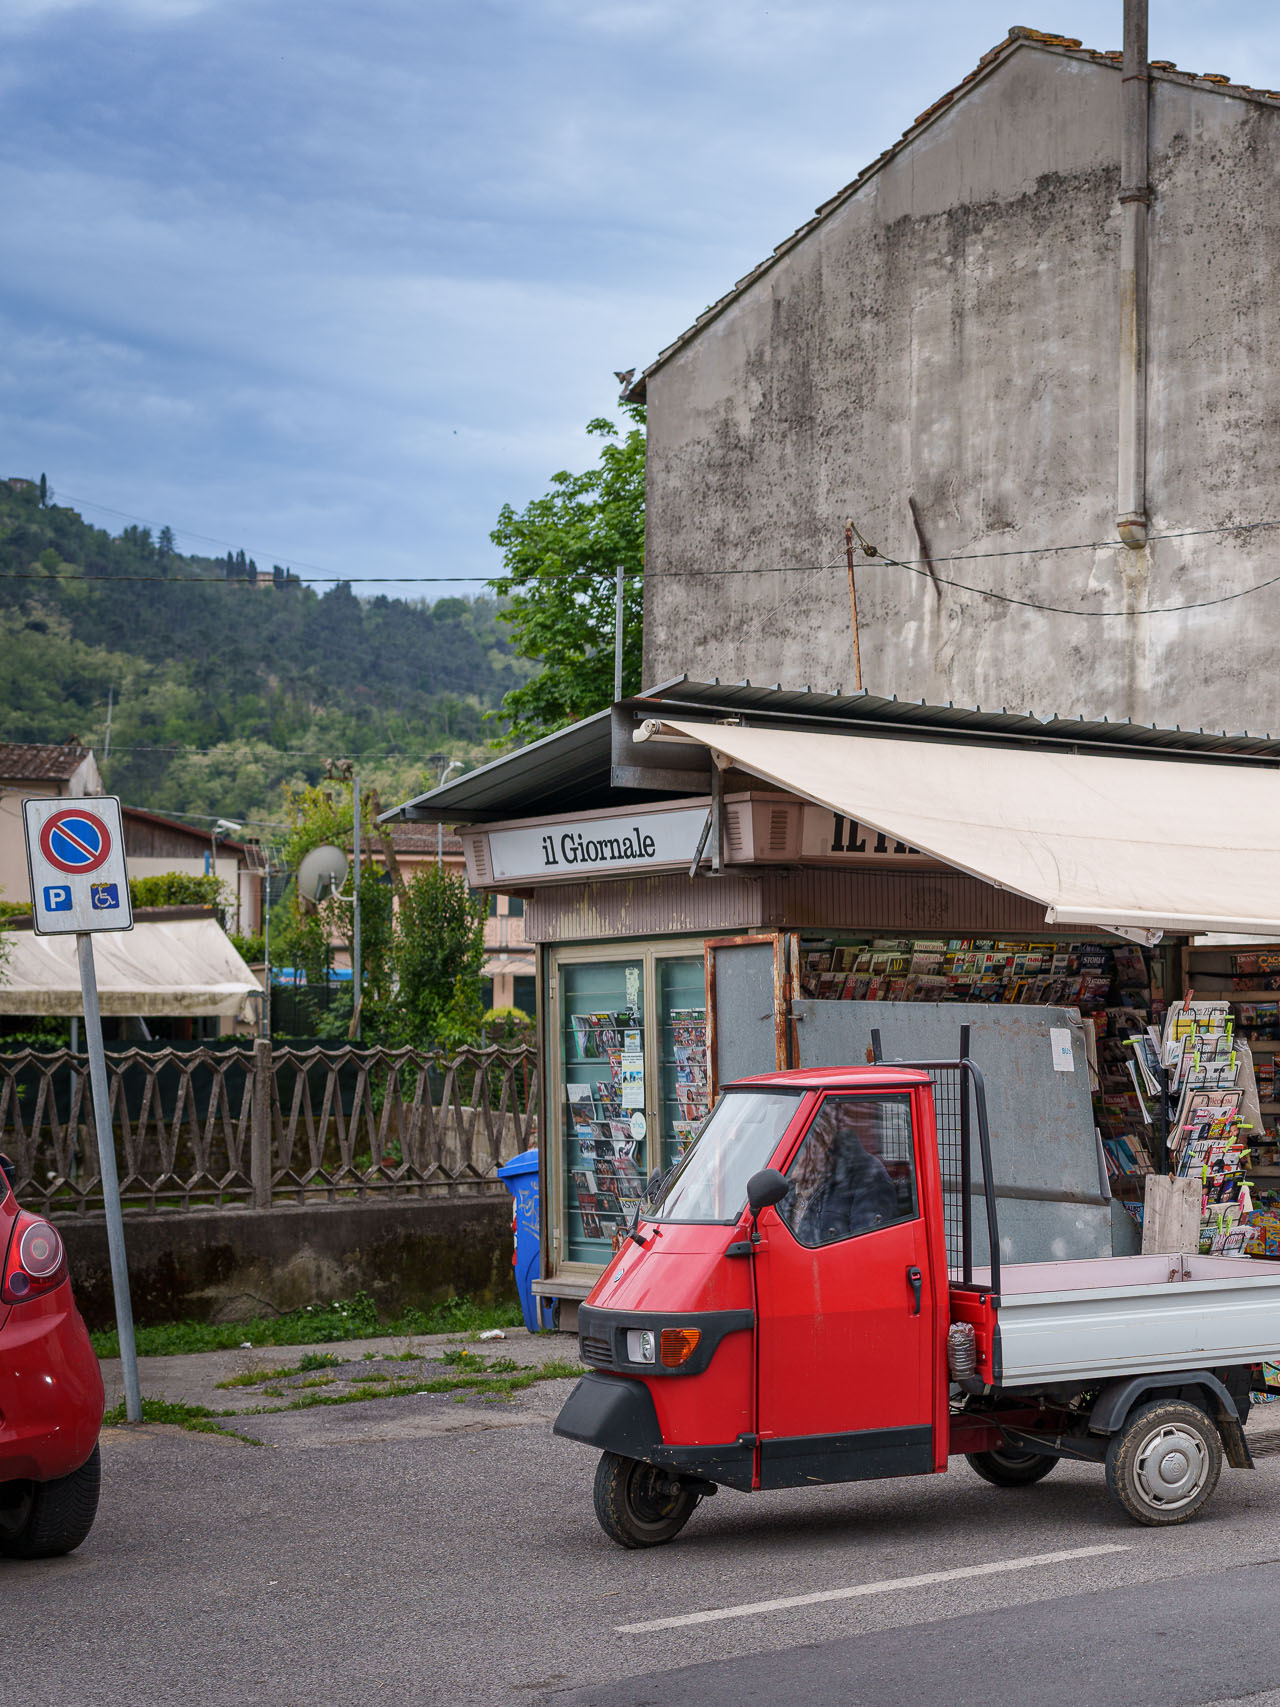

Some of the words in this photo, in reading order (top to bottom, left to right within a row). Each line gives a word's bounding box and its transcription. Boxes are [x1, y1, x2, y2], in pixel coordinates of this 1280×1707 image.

[542, 835, 559, 866] il
[560, 827, 656, 864] Giornale
[48, 888, 66, 909] P
